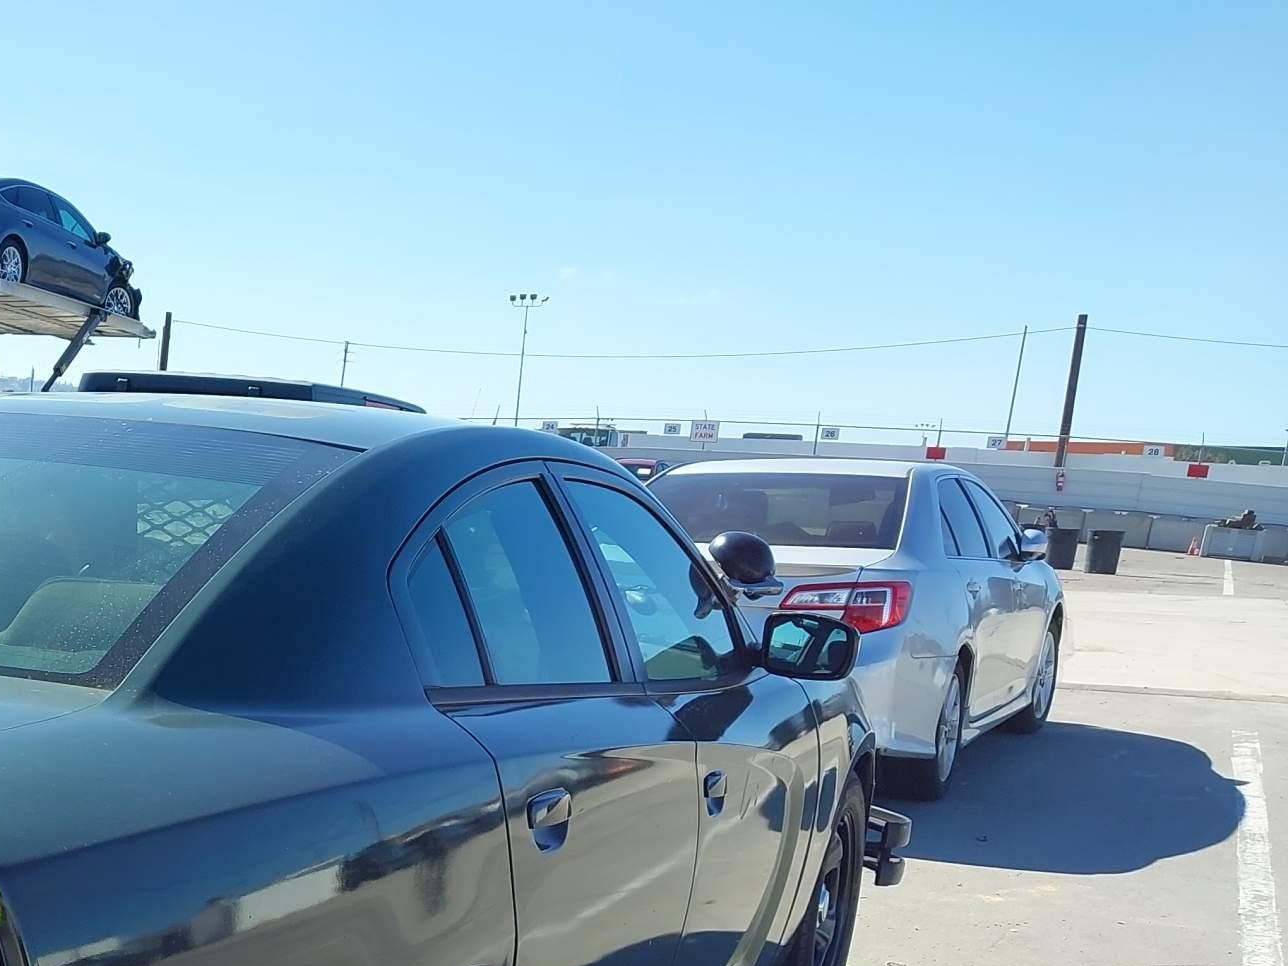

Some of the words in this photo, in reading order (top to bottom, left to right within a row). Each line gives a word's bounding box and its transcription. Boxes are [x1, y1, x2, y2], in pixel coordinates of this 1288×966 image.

[695, 423, 716, 431] STATE
[824, 430, 835, 438] 26
[991, 439, 1002, 447] 27
